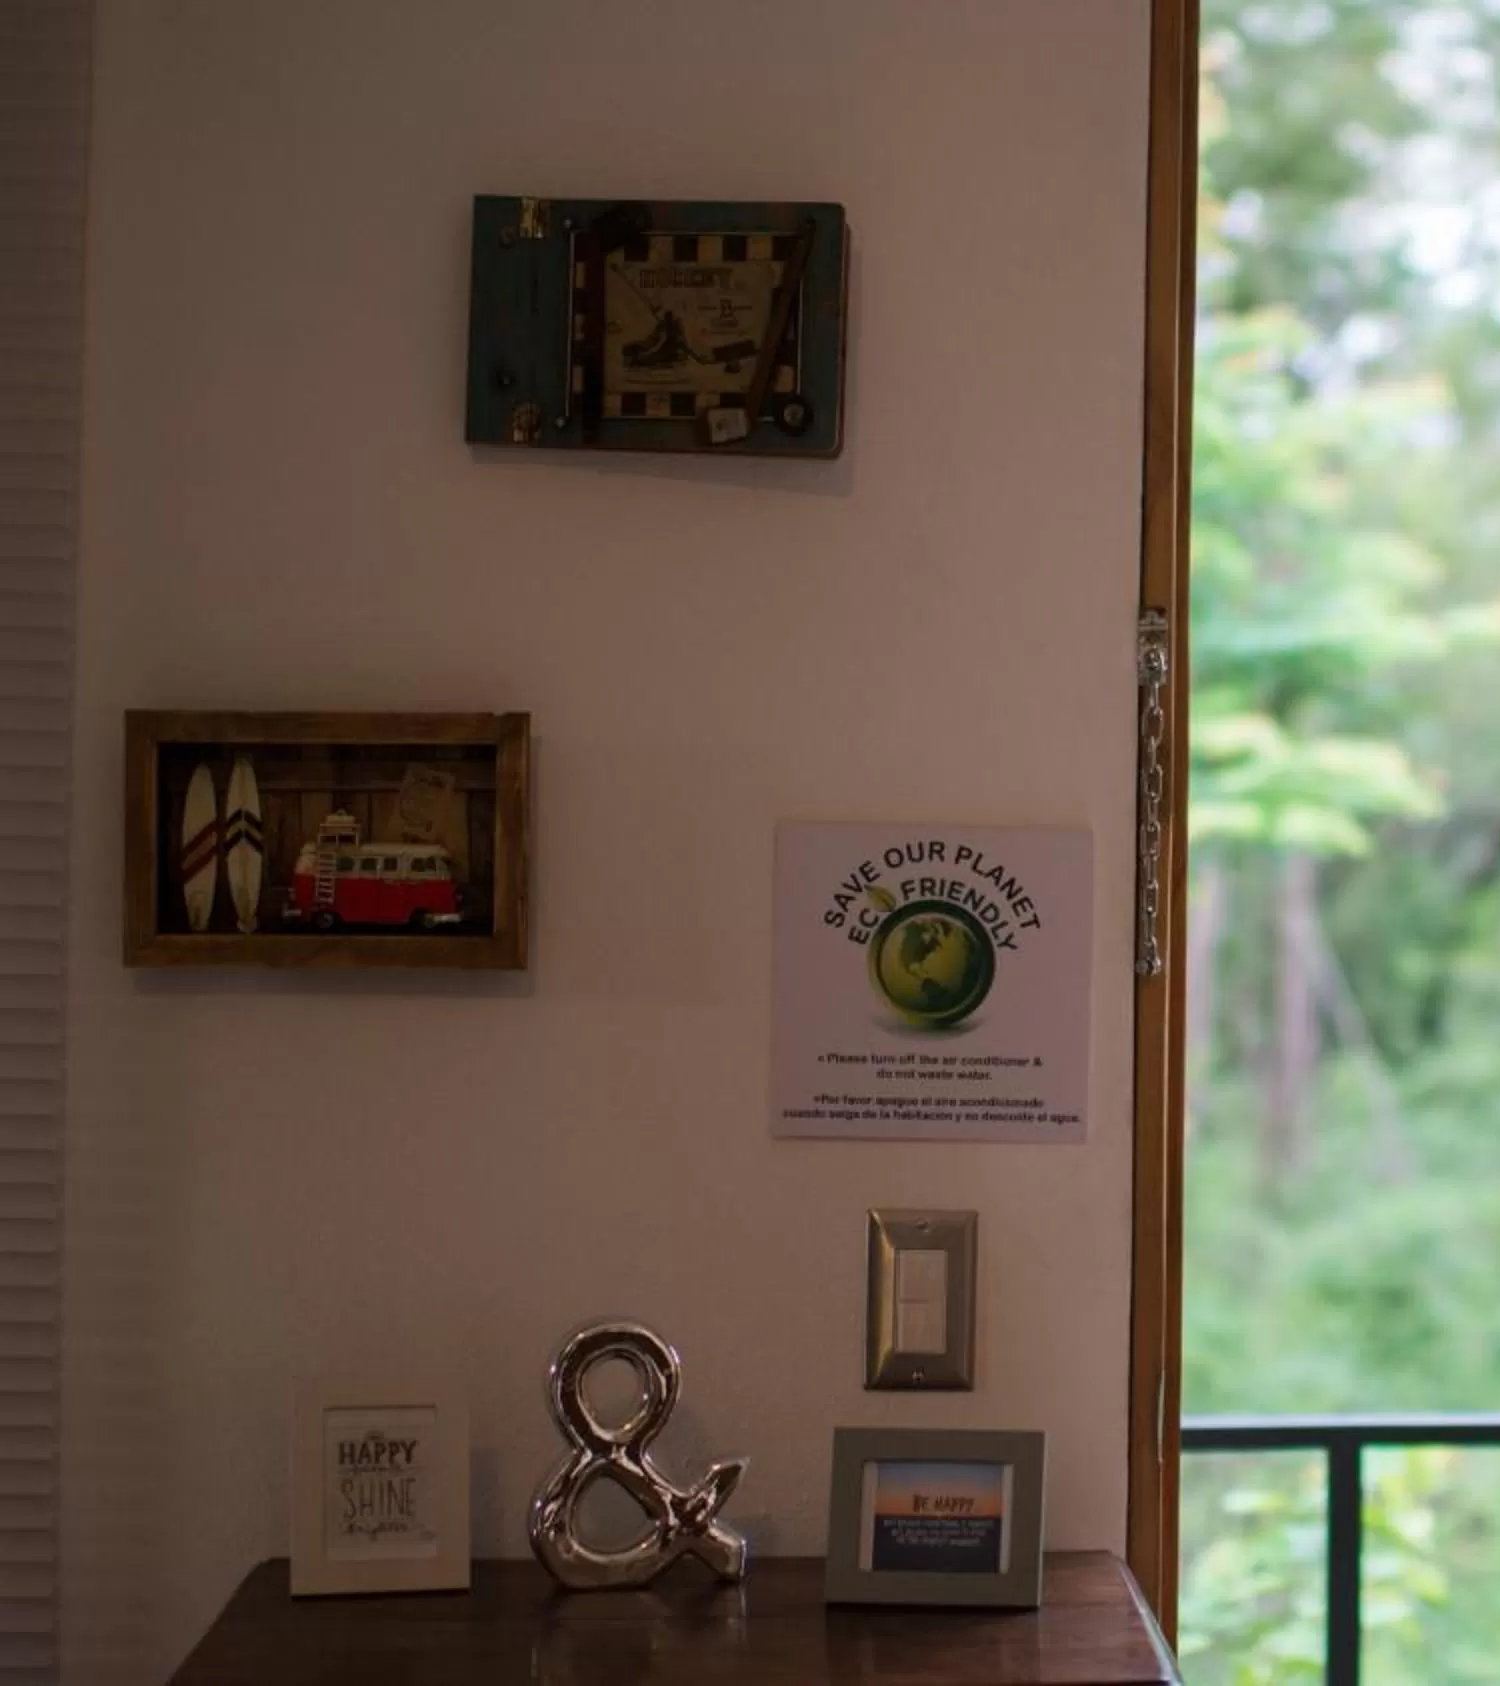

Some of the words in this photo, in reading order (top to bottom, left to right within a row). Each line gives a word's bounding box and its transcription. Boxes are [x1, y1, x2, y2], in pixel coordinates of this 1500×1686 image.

[824, 859, 881, 929] SAVE
[883, 840, 946, 869] OUR
[954, 844, 1041, 931] PLANET
[899, 876, 1019, 952] FRIENDLY
[827, 1053, 868, 1065] Please
[871, 1053, 897, 1065] turn
[899, 1053, 916, 1065] off
[919, 1054, 939, 1065] the
[942, 1055, 957, 1066] air
[960, 1055, 1030, 1067] conditioner
[1032, 1056, 1043, 1067] &
[876, 1068, 893, 1079] do
[895, 1069, 915, 1080] not
[917, 1069, 953, 1080] waste
[338, 1439, 419, 1465] HAPPY
[339, 1477, 417, 1521] SHINE
[933, 1495, 976, 1513] HAPPY
